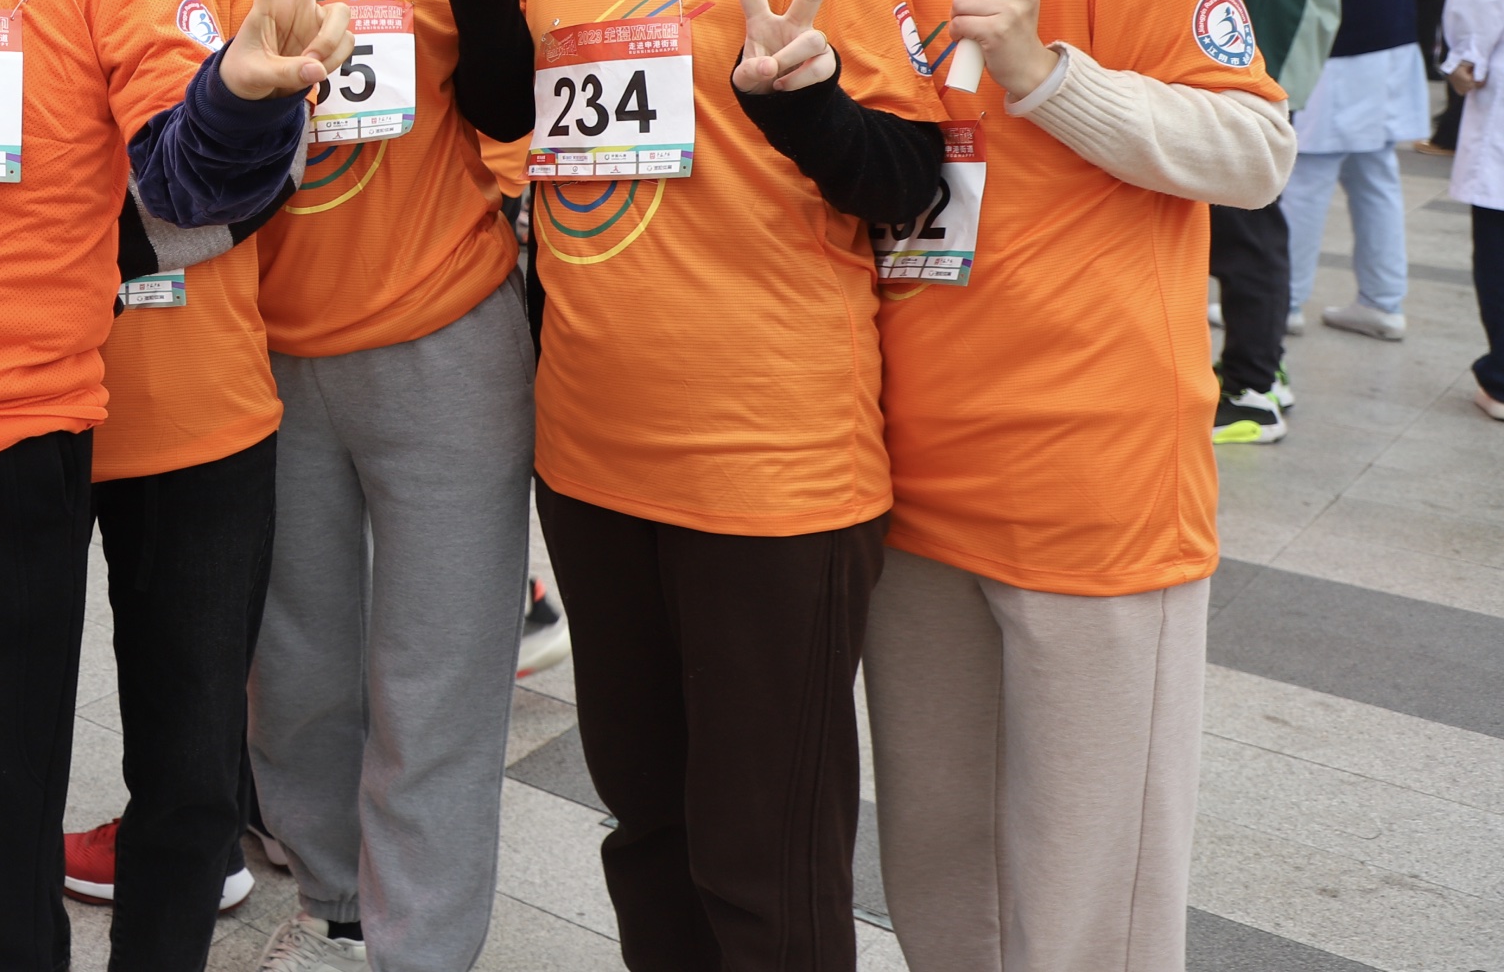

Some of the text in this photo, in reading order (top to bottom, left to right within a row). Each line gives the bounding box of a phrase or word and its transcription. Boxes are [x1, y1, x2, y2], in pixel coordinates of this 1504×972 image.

[577, 29, 603, 46] 2023
[628, 39, 679, 49] 走进申港街道
[548, 70, 657, 137] 234
